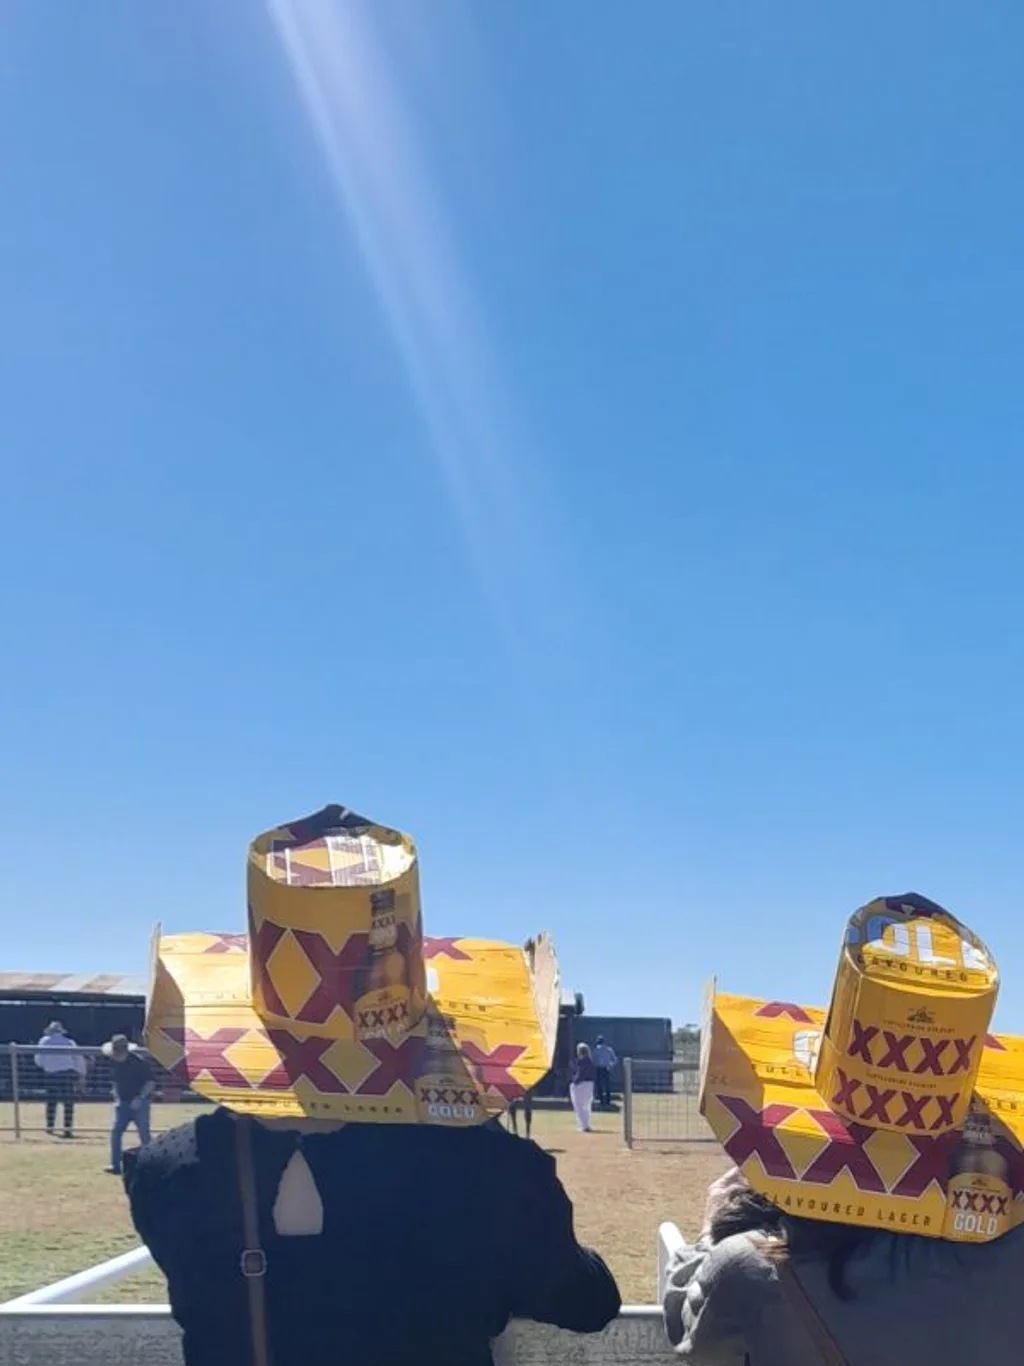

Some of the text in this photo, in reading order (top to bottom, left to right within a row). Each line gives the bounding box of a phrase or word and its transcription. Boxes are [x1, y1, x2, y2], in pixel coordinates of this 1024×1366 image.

[847, 1019, 977, 1076] XXXX
[832, 1067, 961, 1130] XXXX
[952, 1190, 1008, 1216] XXXX
[877, 1208, 932, 1228] LAGER
[954, 1212, 998, 1235] GOLD
